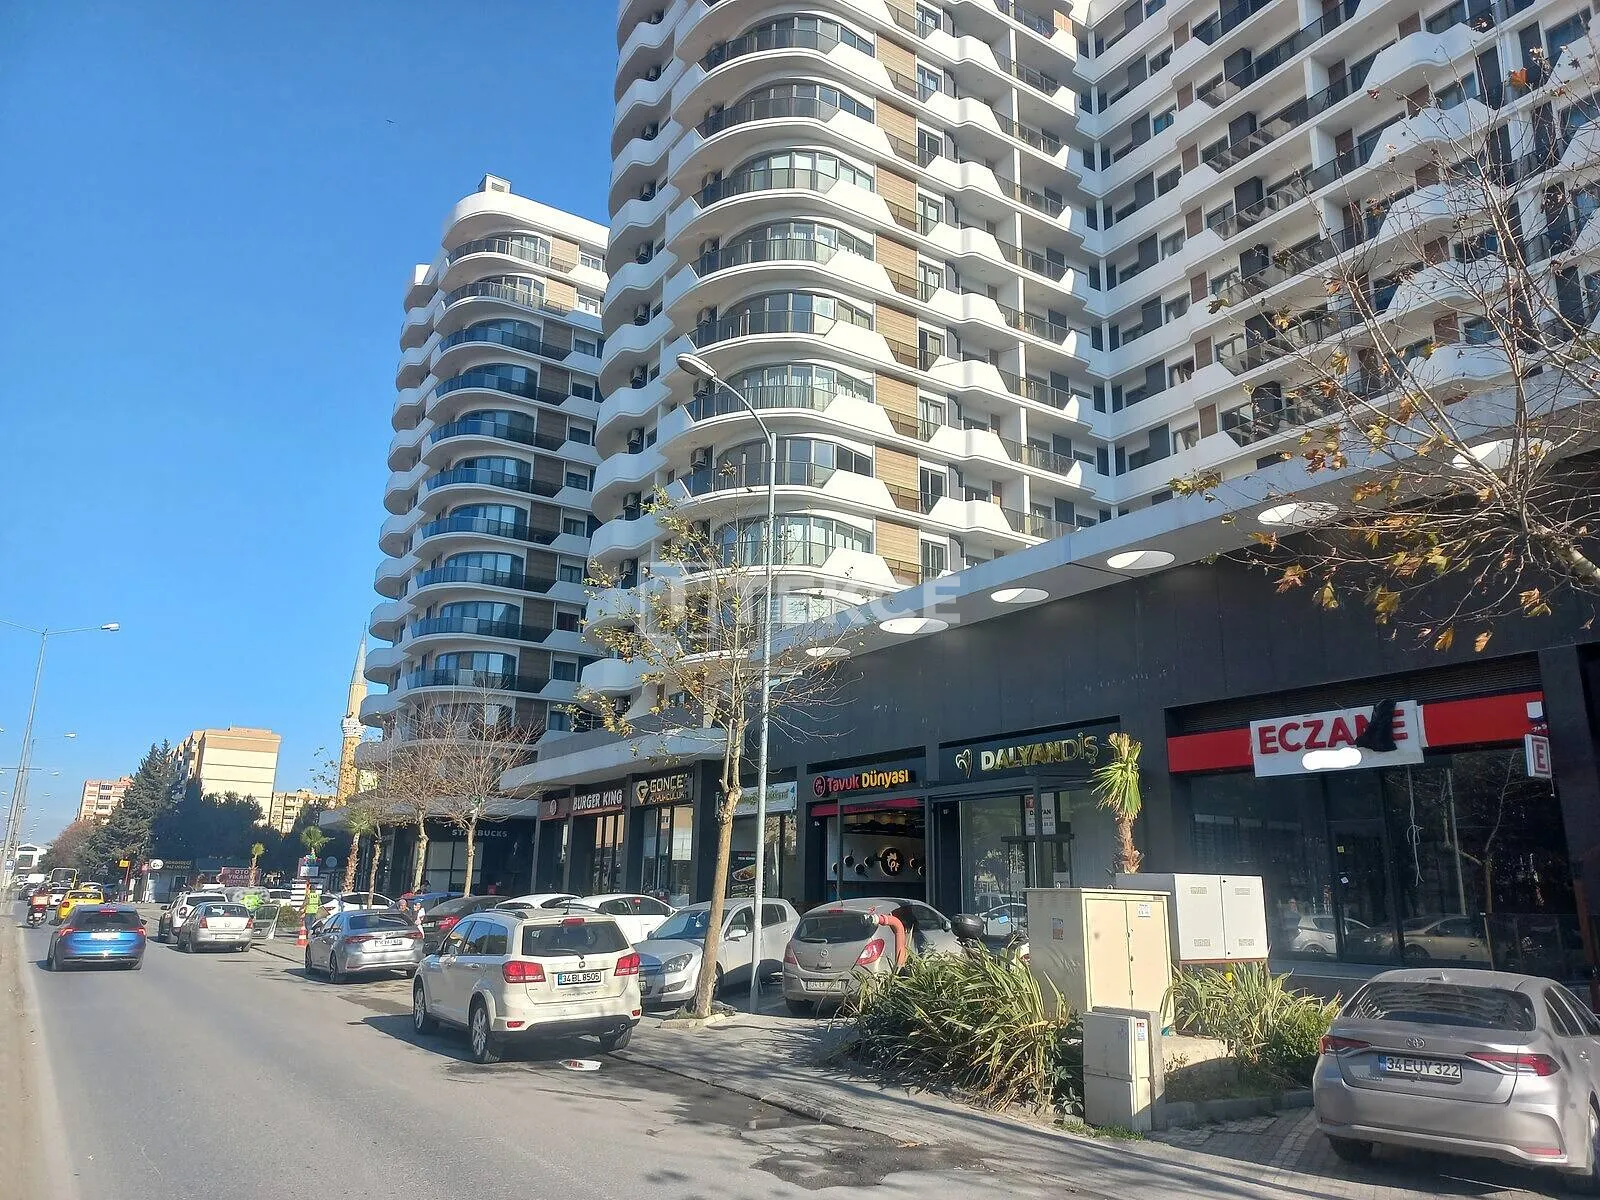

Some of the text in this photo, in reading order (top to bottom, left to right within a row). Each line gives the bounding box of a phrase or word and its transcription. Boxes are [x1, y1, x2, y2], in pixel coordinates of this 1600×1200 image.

[827, 769, 909, 792] Tavuk Dünyası
[572, 789, 623, 811] BURGER KING
[451, 829, 508, 838] STBUCKS
[562, 974, 571, 983] 34
[1386, 1057, 1460, 1078] 34 EUY 322
